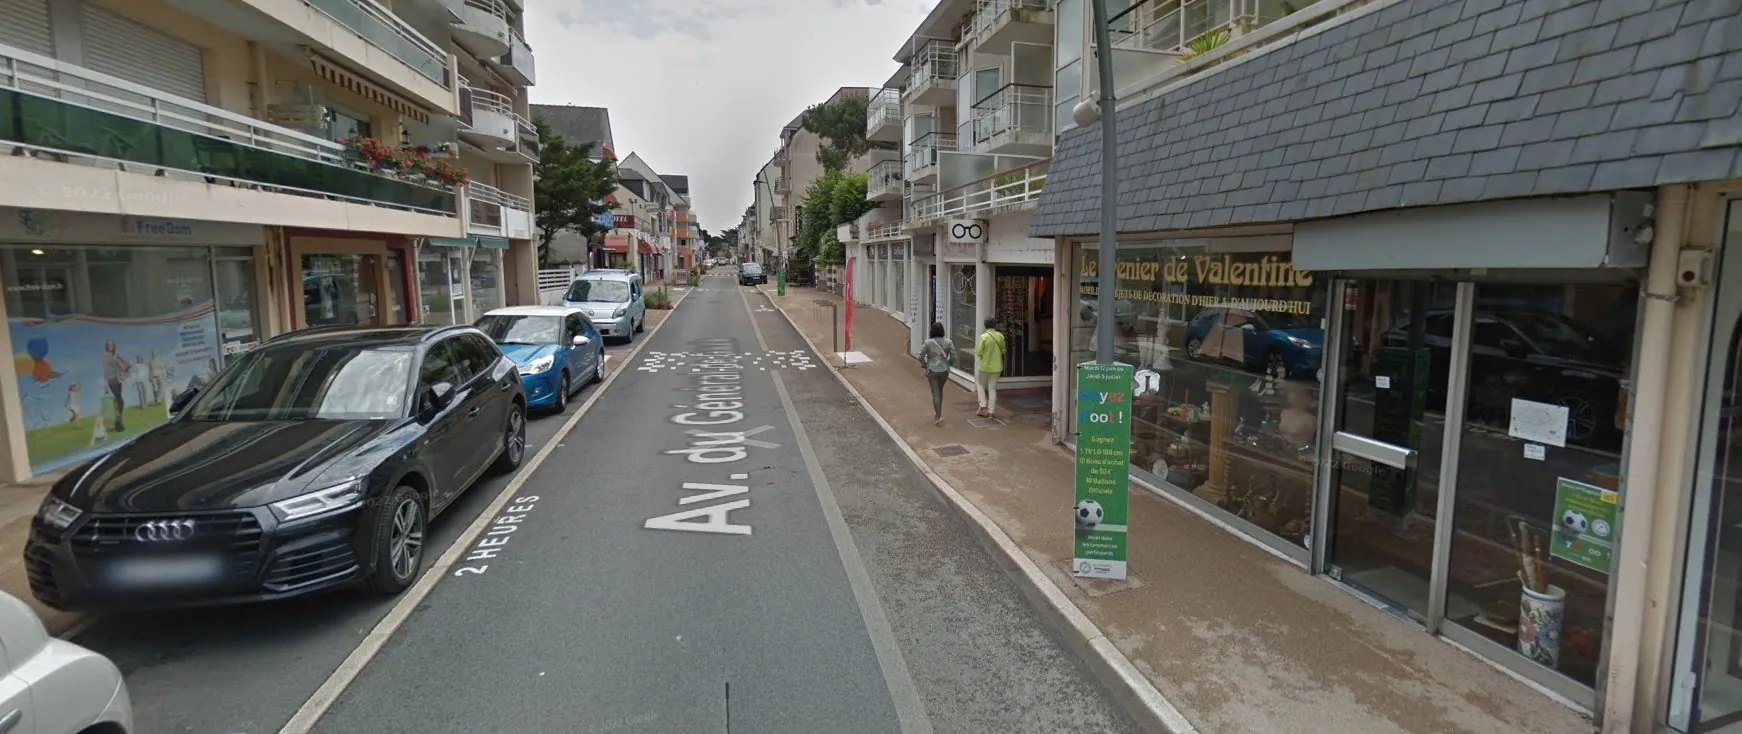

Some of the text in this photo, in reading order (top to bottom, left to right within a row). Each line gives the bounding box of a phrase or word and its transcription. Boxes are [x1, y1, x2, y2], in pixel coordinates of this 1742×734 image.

[1080, 253, 1313, 288] Le enier de Valentine
[1114, 288, 1132, 300] BJETS
[1133, 290, 1143, 300] DE
[1143, 289, 1191, 305] DÉCORATION
[1191, 294, 1218, 307] D'HIER
[1231, 297, 1311, 315] D'AUJOURD'HUI
[1091, 436, 1114, 444] Gagnez
[1093, 477, 1117, 485] Ballons
[455, 495, 540, 577] 2 HEURES
